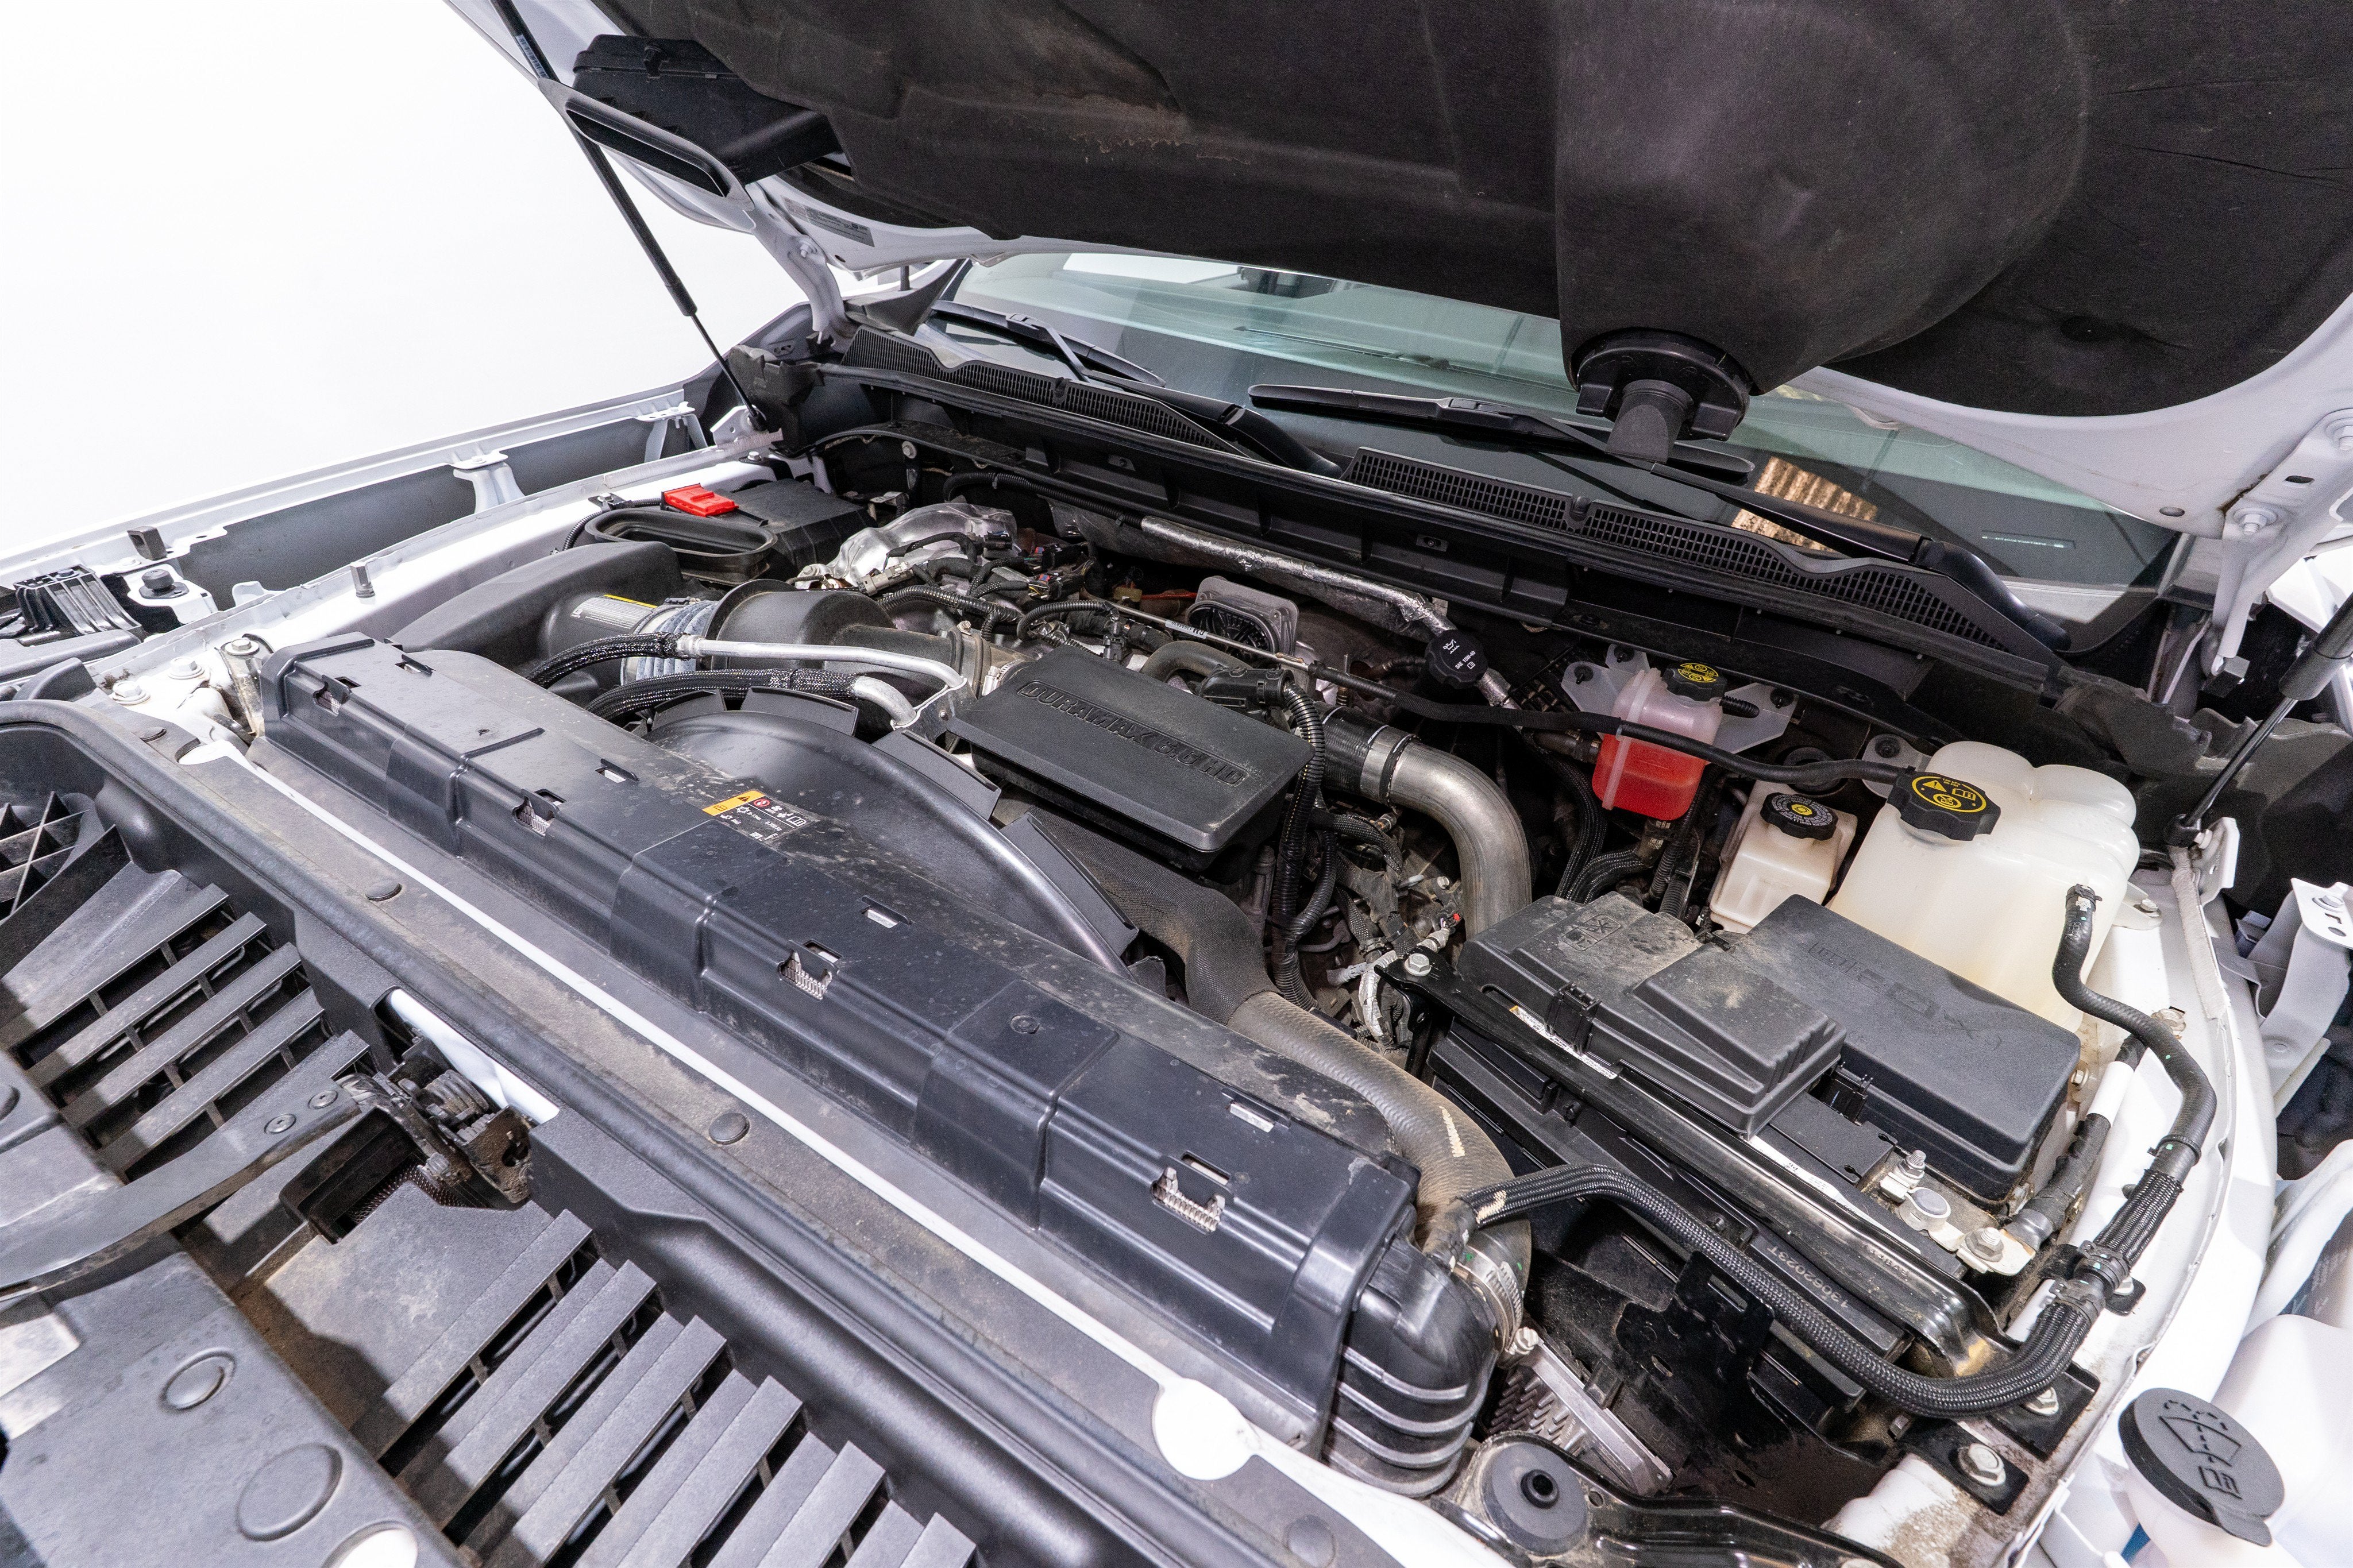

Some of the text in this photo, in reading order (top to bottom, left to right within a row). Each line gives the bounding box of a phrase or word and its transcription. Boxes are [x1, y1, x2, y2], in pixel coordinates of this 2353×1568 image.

[1455, 651, 1476, 669] SAE 15W-40
[1020, 683, 1246, 785] DURAMAX 6.6 HD
[1766, 1243, 1850, 1310] 13062023T
